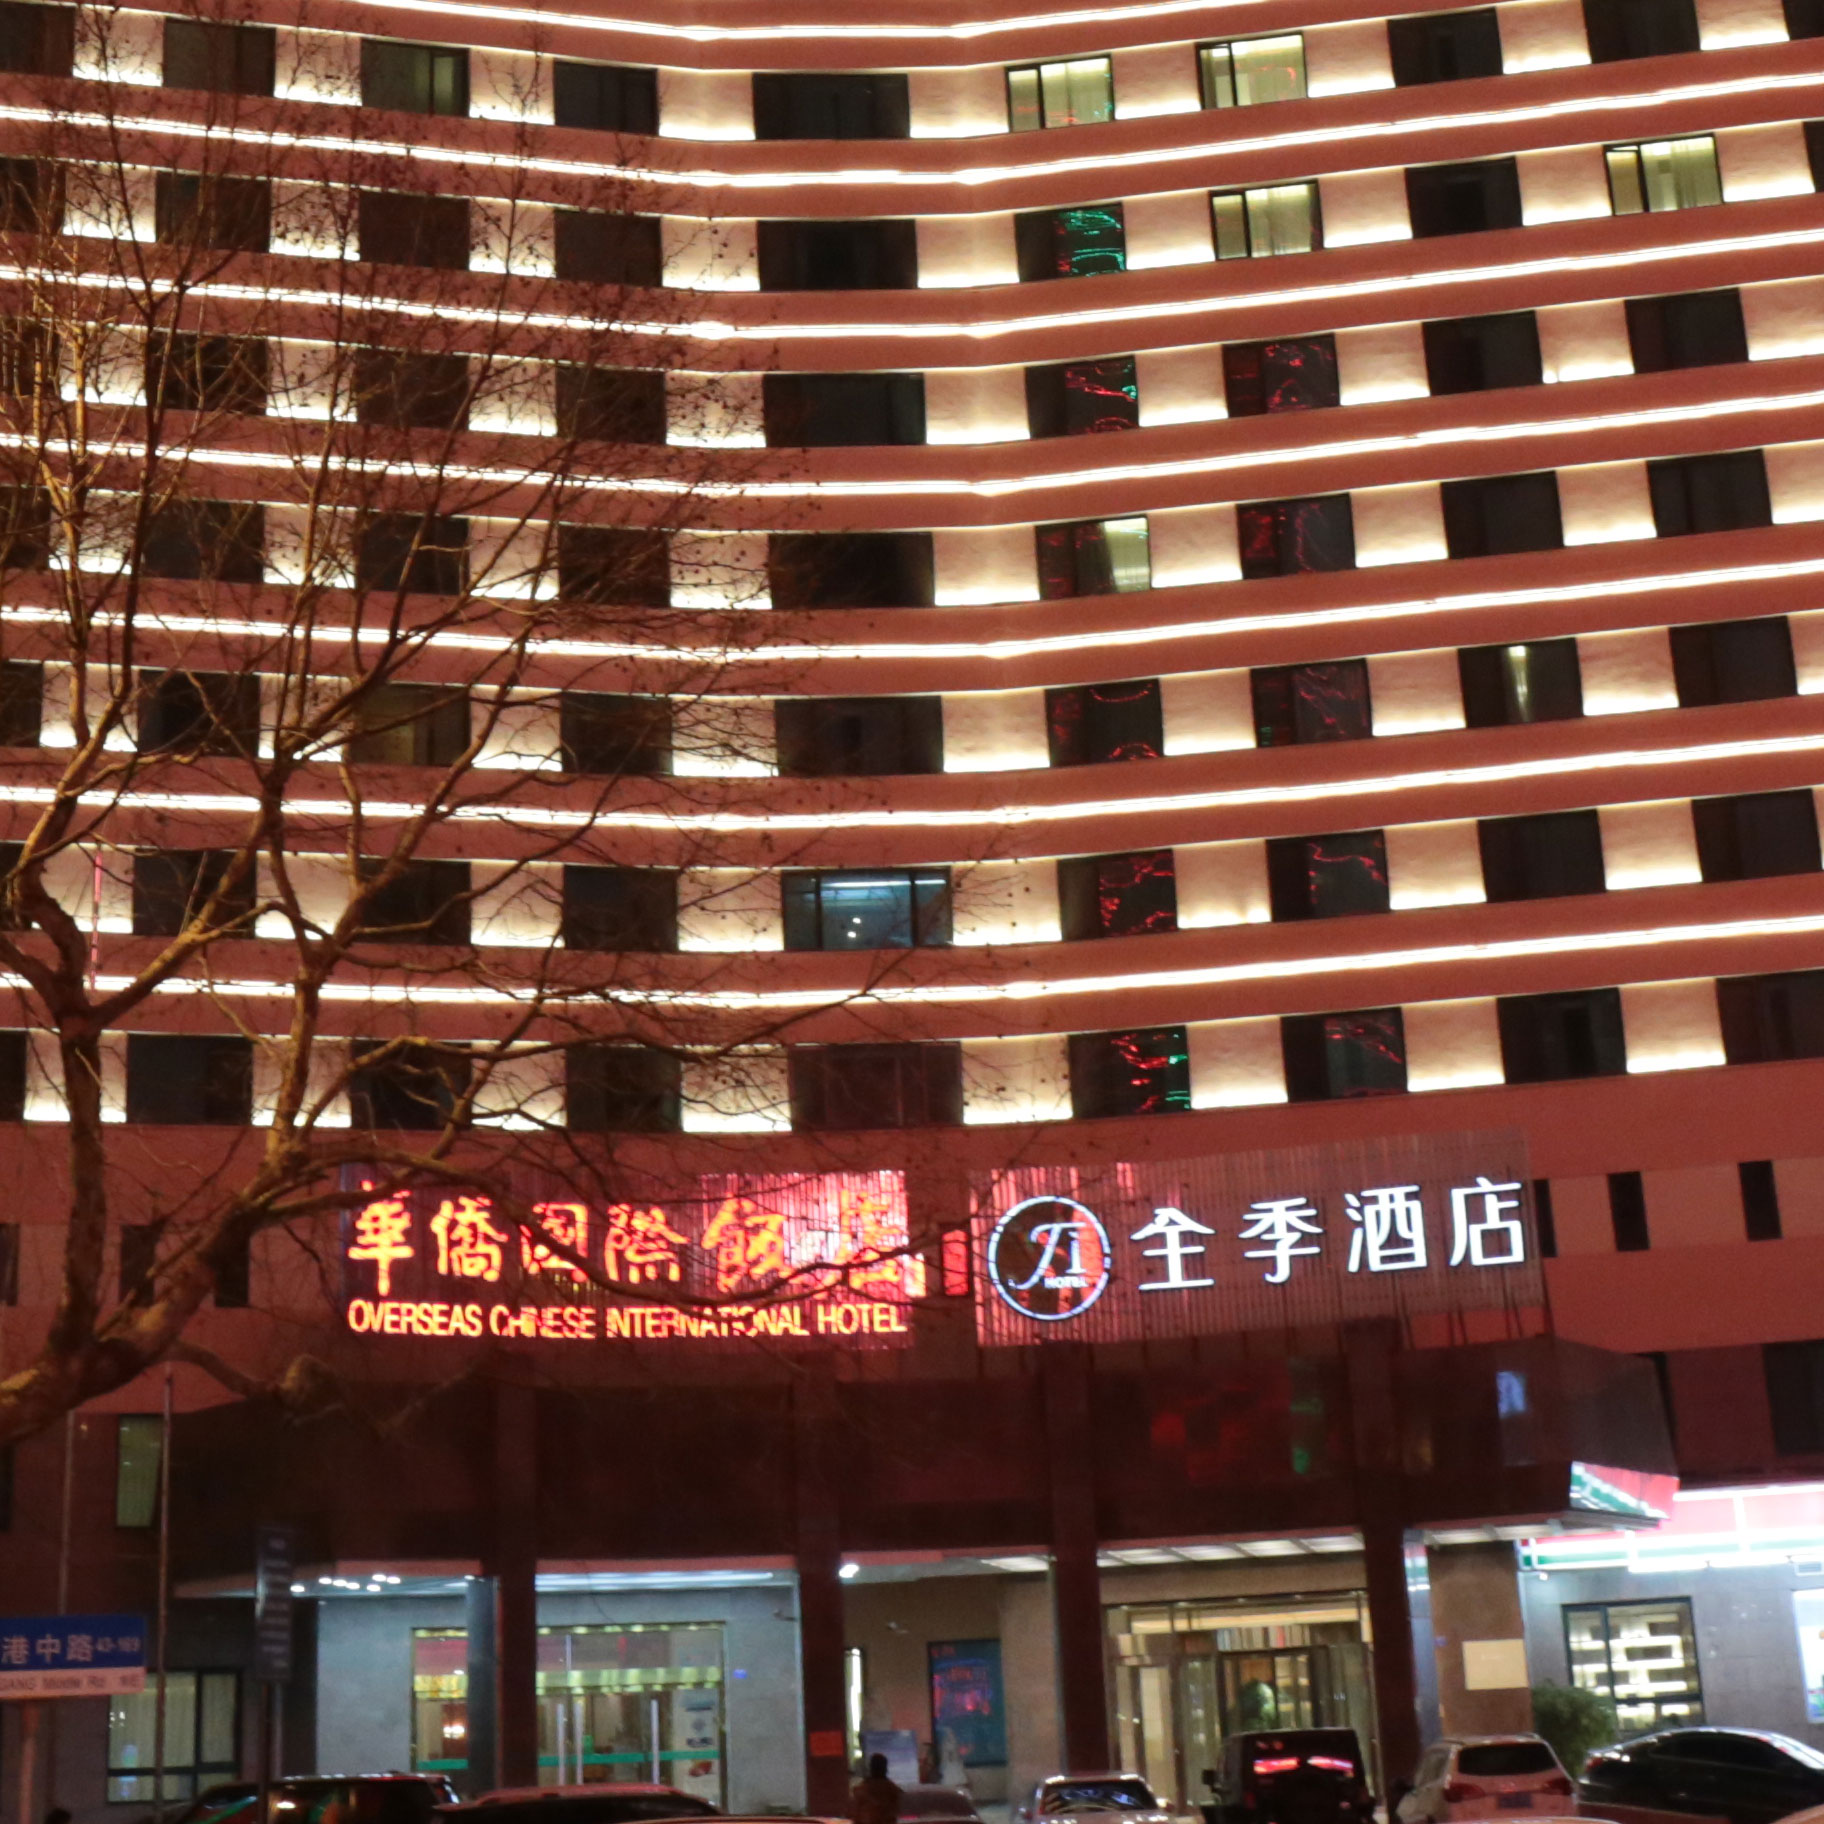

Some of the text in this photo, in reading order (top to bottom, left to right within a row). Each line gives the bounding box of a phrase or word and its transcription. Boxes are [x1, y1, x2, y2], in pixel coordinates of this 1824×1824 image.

[1130, 1177, 1525, 1292] 全季酒店
[348, 1298, 483, 1337] OVERSEAS
[817, 1303, 908, 1335] HOTEL
